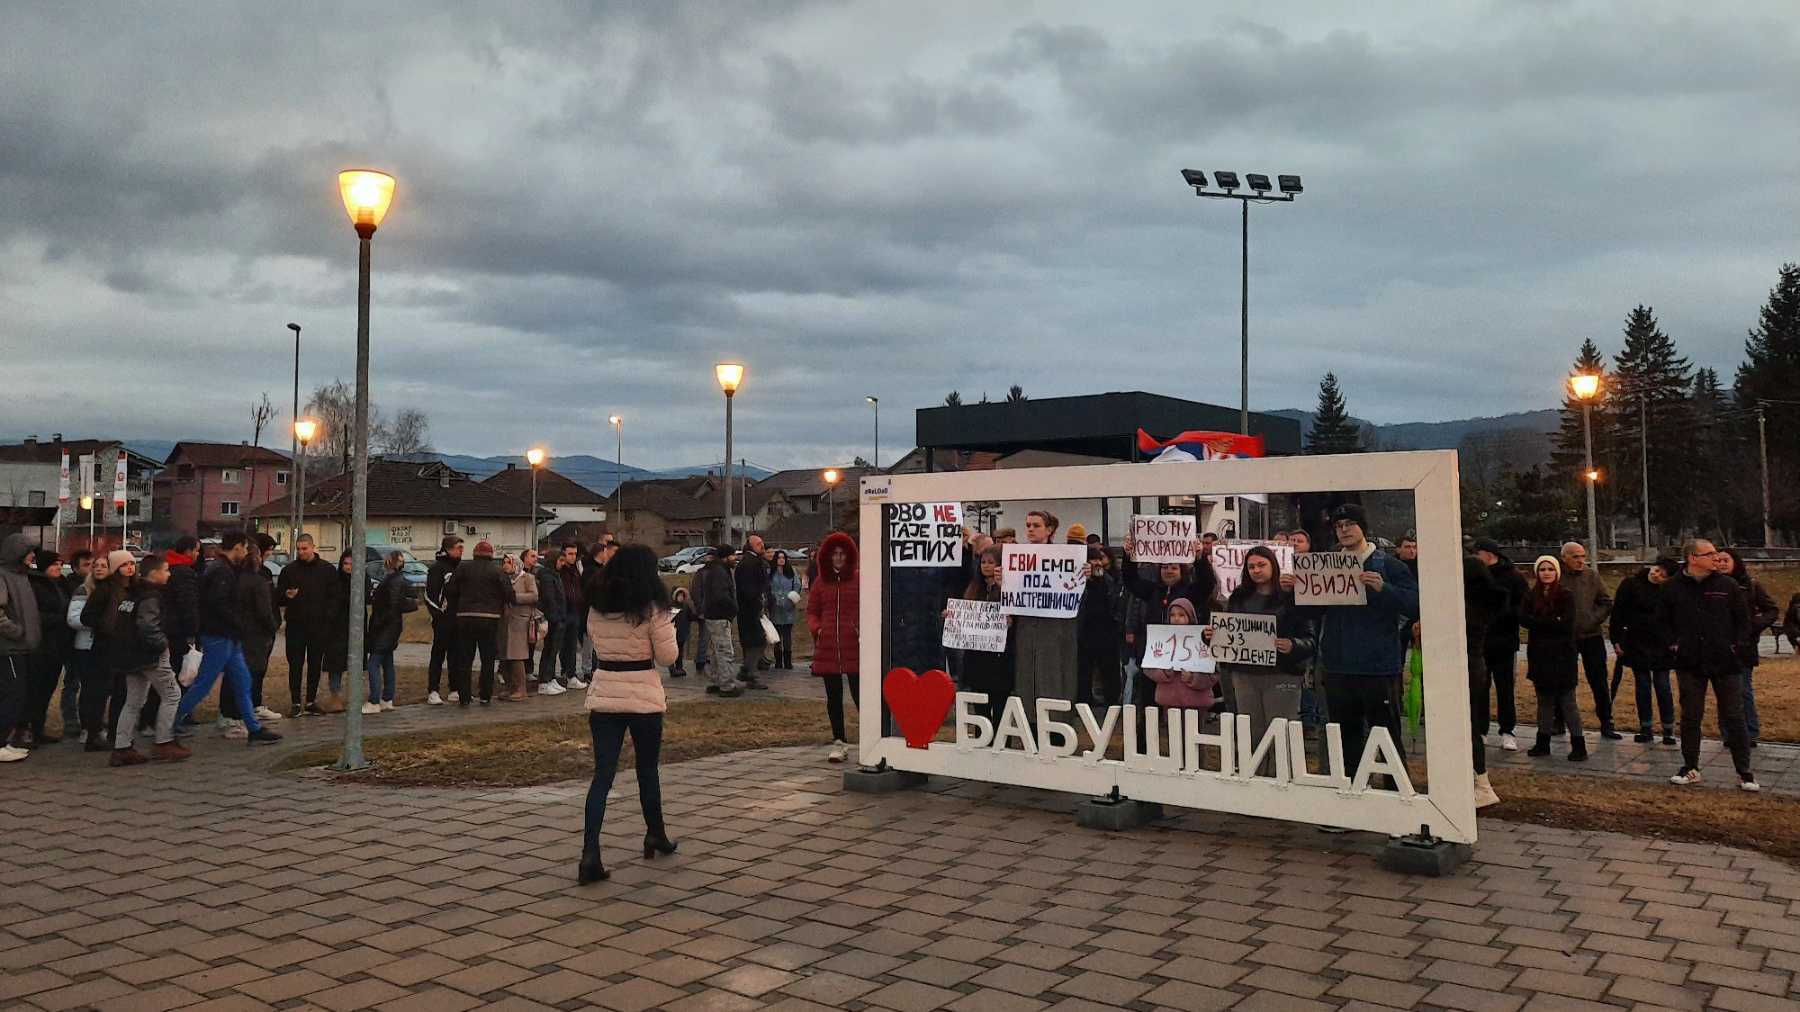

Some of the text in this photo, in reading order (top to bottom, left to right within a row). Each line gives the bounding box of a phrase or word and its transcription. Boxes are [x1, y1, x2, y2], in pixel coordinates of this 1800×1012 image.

[933, 504, 957, 523] НЕ
[936, 523, 962, 539] ПОД
[1136, 519, 1191, 537] PROTIV
[1136, 539, 1196, 558] OKUPATORA
[1008, 553, 1075, 573] СВИ СМО
[1293, 553, 1361, 572] КОРУПЦИЈА
[1023, 574, 1052, 588] ПОД
[1298, 574, 1360, 596] УБИЈА
[1211, 615, 1277, 636] БАБУШНИЦА
[1227, 632, 1246, 647] УЗ
[1210, 645, 1276, 665] СТУДЕНТЕ
[954, 691, 1417, 797] БАБУШНИЦА
